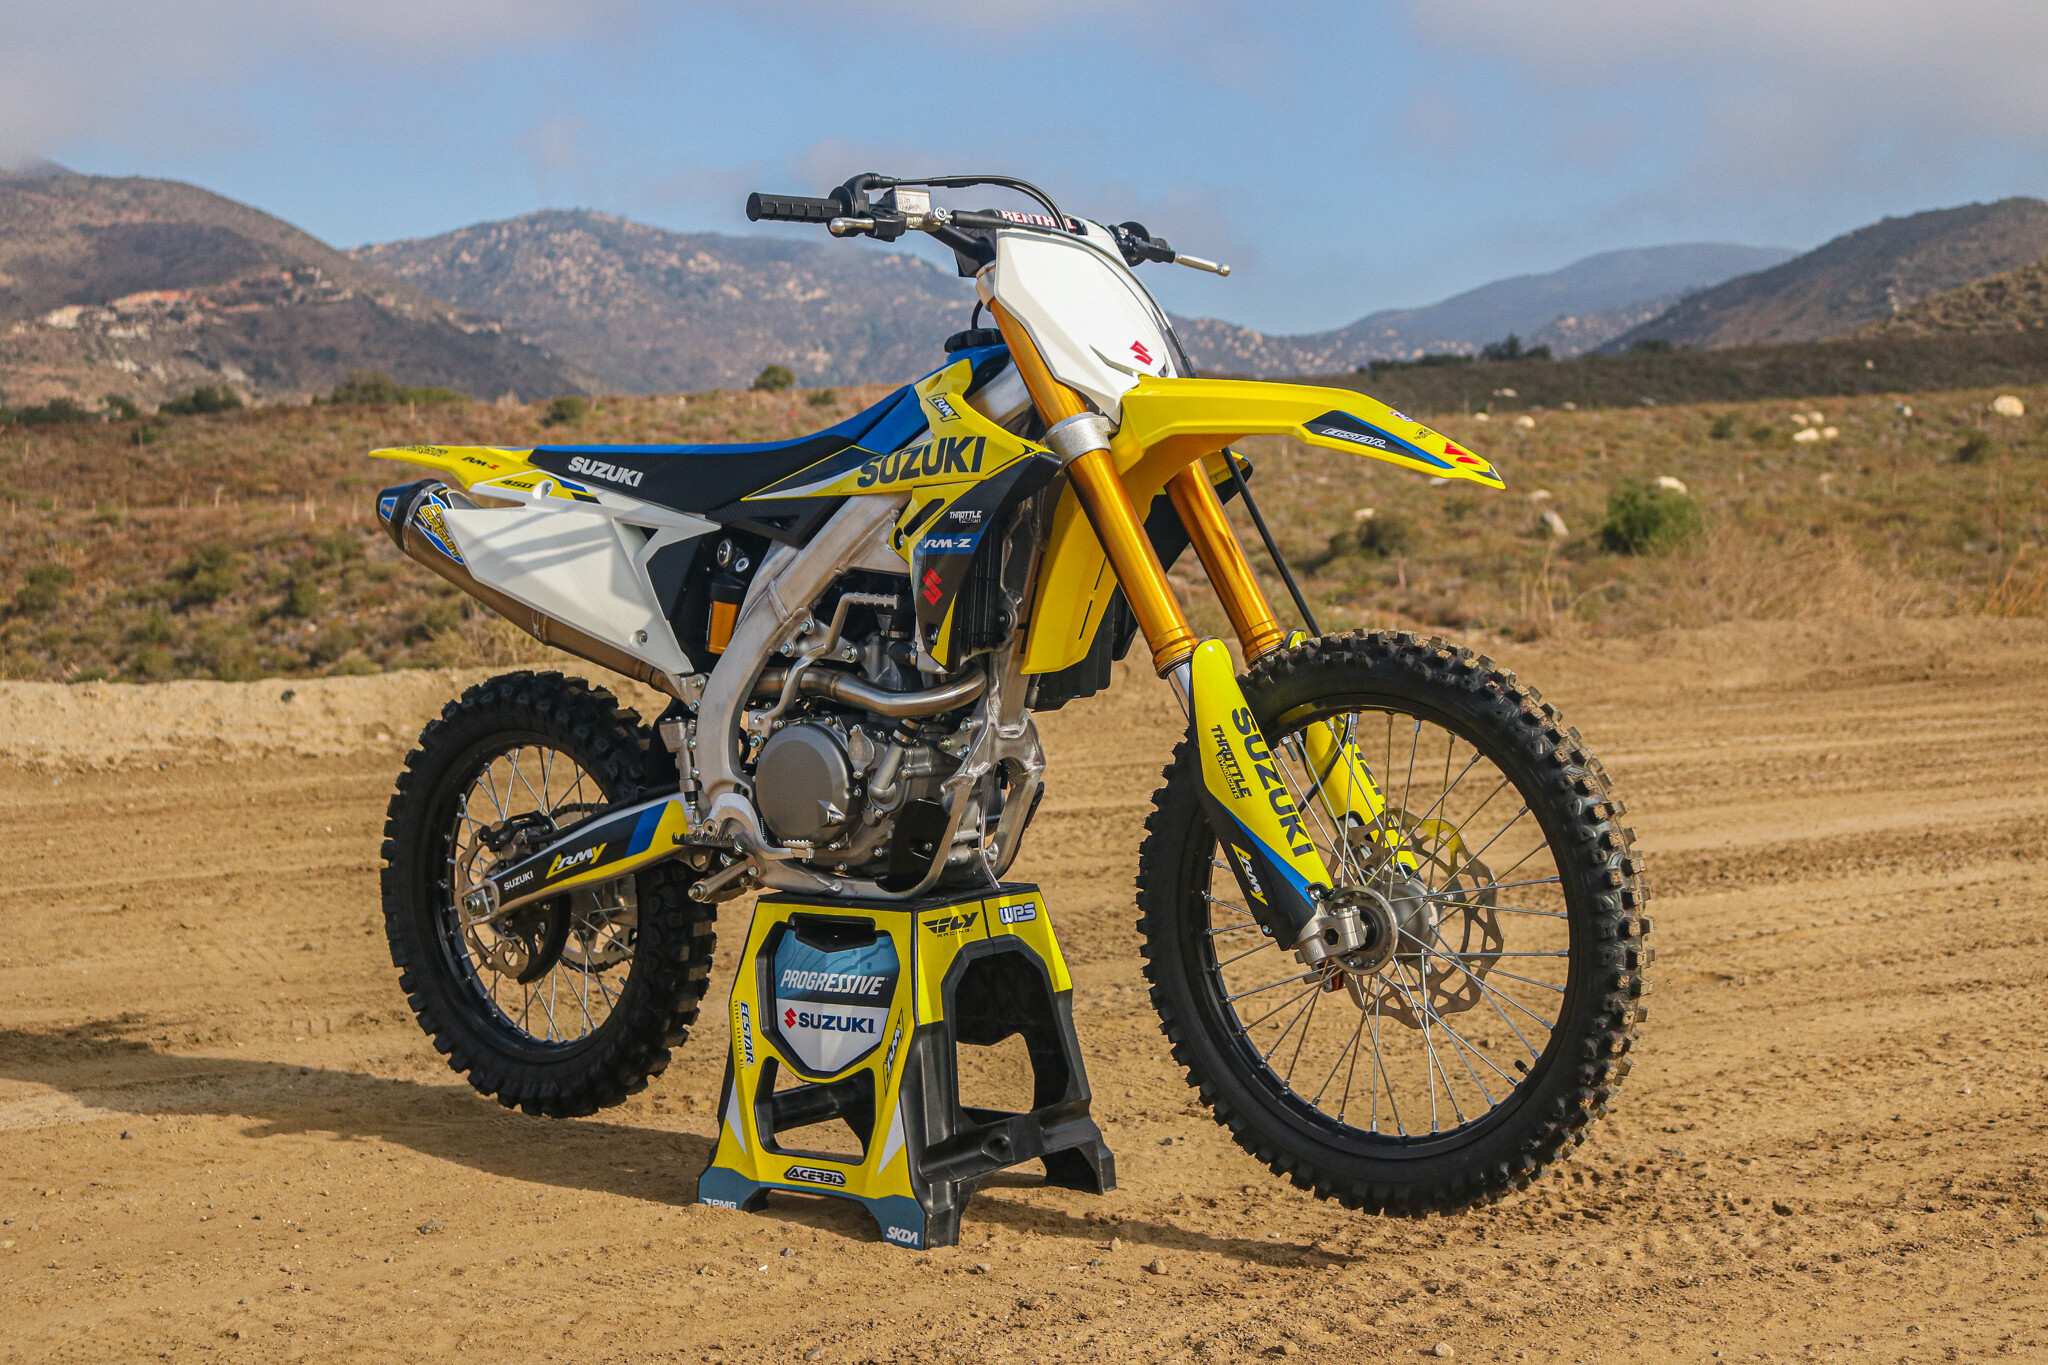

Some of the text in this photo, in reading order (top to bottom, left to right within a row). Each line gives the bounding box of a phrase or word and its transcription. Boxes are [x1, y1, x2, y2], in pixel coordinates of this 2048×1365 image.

[1001, 210, 1077, 230] RENTHL
[462, 456, 500, 470] RM-Z
[568, 456, 644, 487] SUZUKI
[857, 436, 986, 488] SUZUKI
[501, 480, 534, 489] 450
[949, 511, 982, 520] THROTTLE
[923, 538, 972, 549] RM-Z
[1211, 724, 1252, 798] THROTTLE
[1231, 707, 1315, 857] SUZUKI
[545, 842, 608, 879] ARMY
[503, 870, 534, 891] SUZUKI
[922, 911, 979, 934] FLY
[998, 902, 1037, 925] WPS
[780, 969, 885, 996] PROGRESSIVE
[740, 1000, 756, 1069] ECSTAR
[798, 1012, 875, 1034] SUZUKI
[886, 1226, 919, 1245] SKDA
